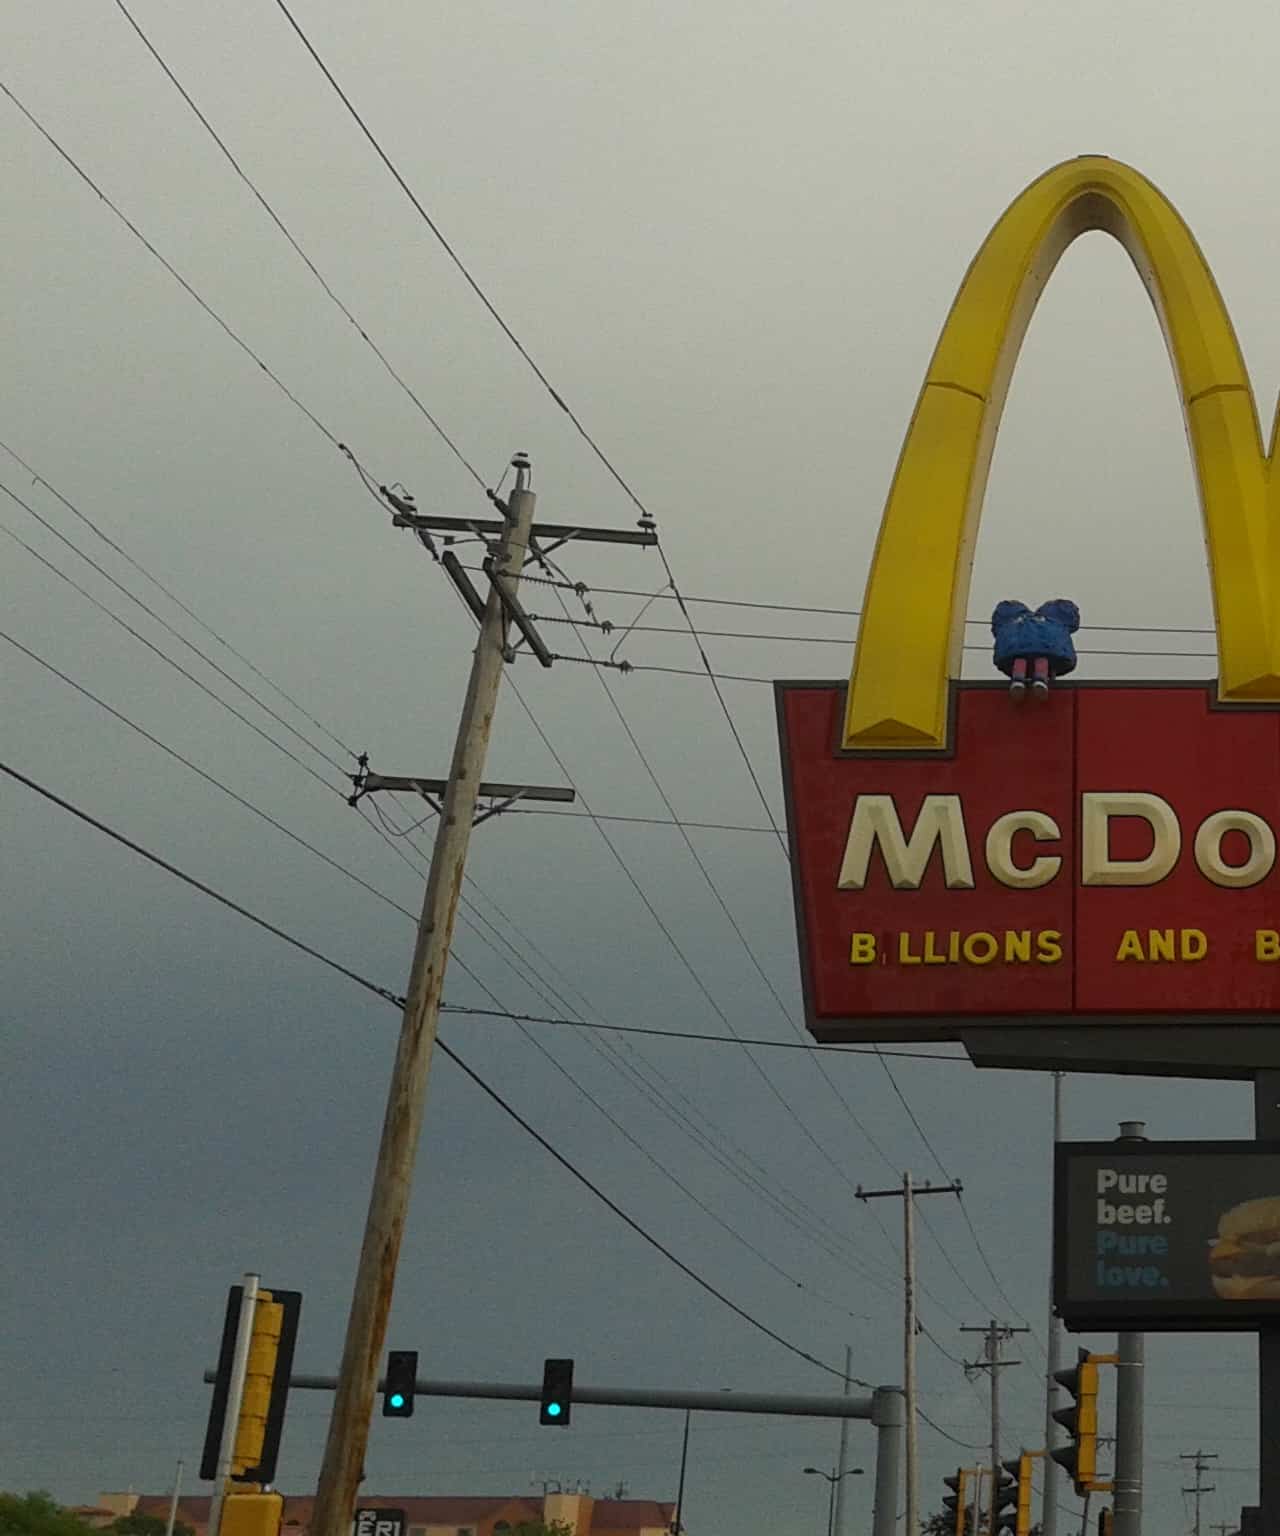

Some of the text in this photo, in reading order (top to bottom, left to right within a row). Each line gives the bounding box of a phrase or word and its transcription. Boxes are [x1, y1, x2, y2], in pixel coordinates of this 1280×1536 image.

[850, 929, 1063, 964] BLLIONS
[1116, 929, 1208, 962] AND
[1096, 1168, 1168, 1194] Pure
[1096, 1198, 1172, 1225] beef.
[1096, 1231, 1169, 1256] Pure
[1096, 1260, 1169, 1287] love.
